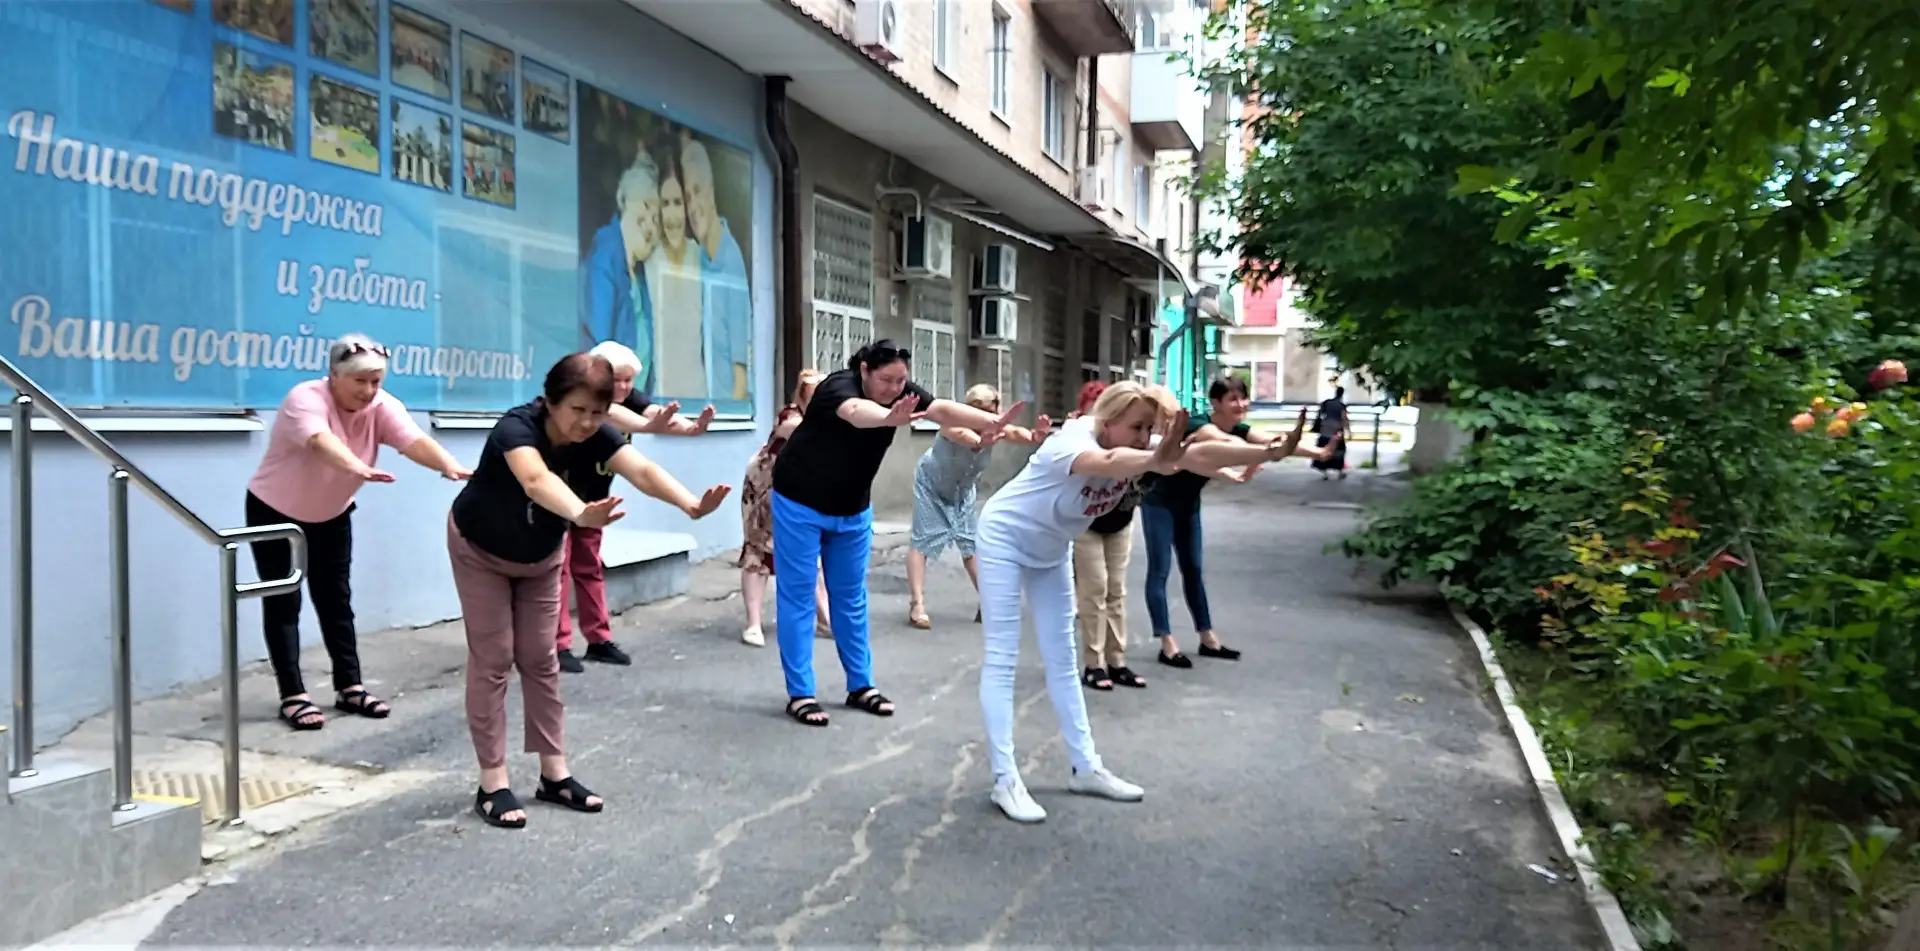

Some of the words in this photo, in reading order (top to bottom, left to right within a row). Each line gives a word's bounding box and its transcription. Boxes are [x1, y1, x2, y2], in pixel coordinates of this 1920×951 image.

[8, 110, 160, 196] Наша
[168, 161, 383, 236] поддержка
[277, 259, 299, 296] и
[307, 256, 427, 314] забота
[11, 294, 160, 363] Ваша
[169, 322, 337, 382] достойн
[391, 343, 535, 390] старость!
